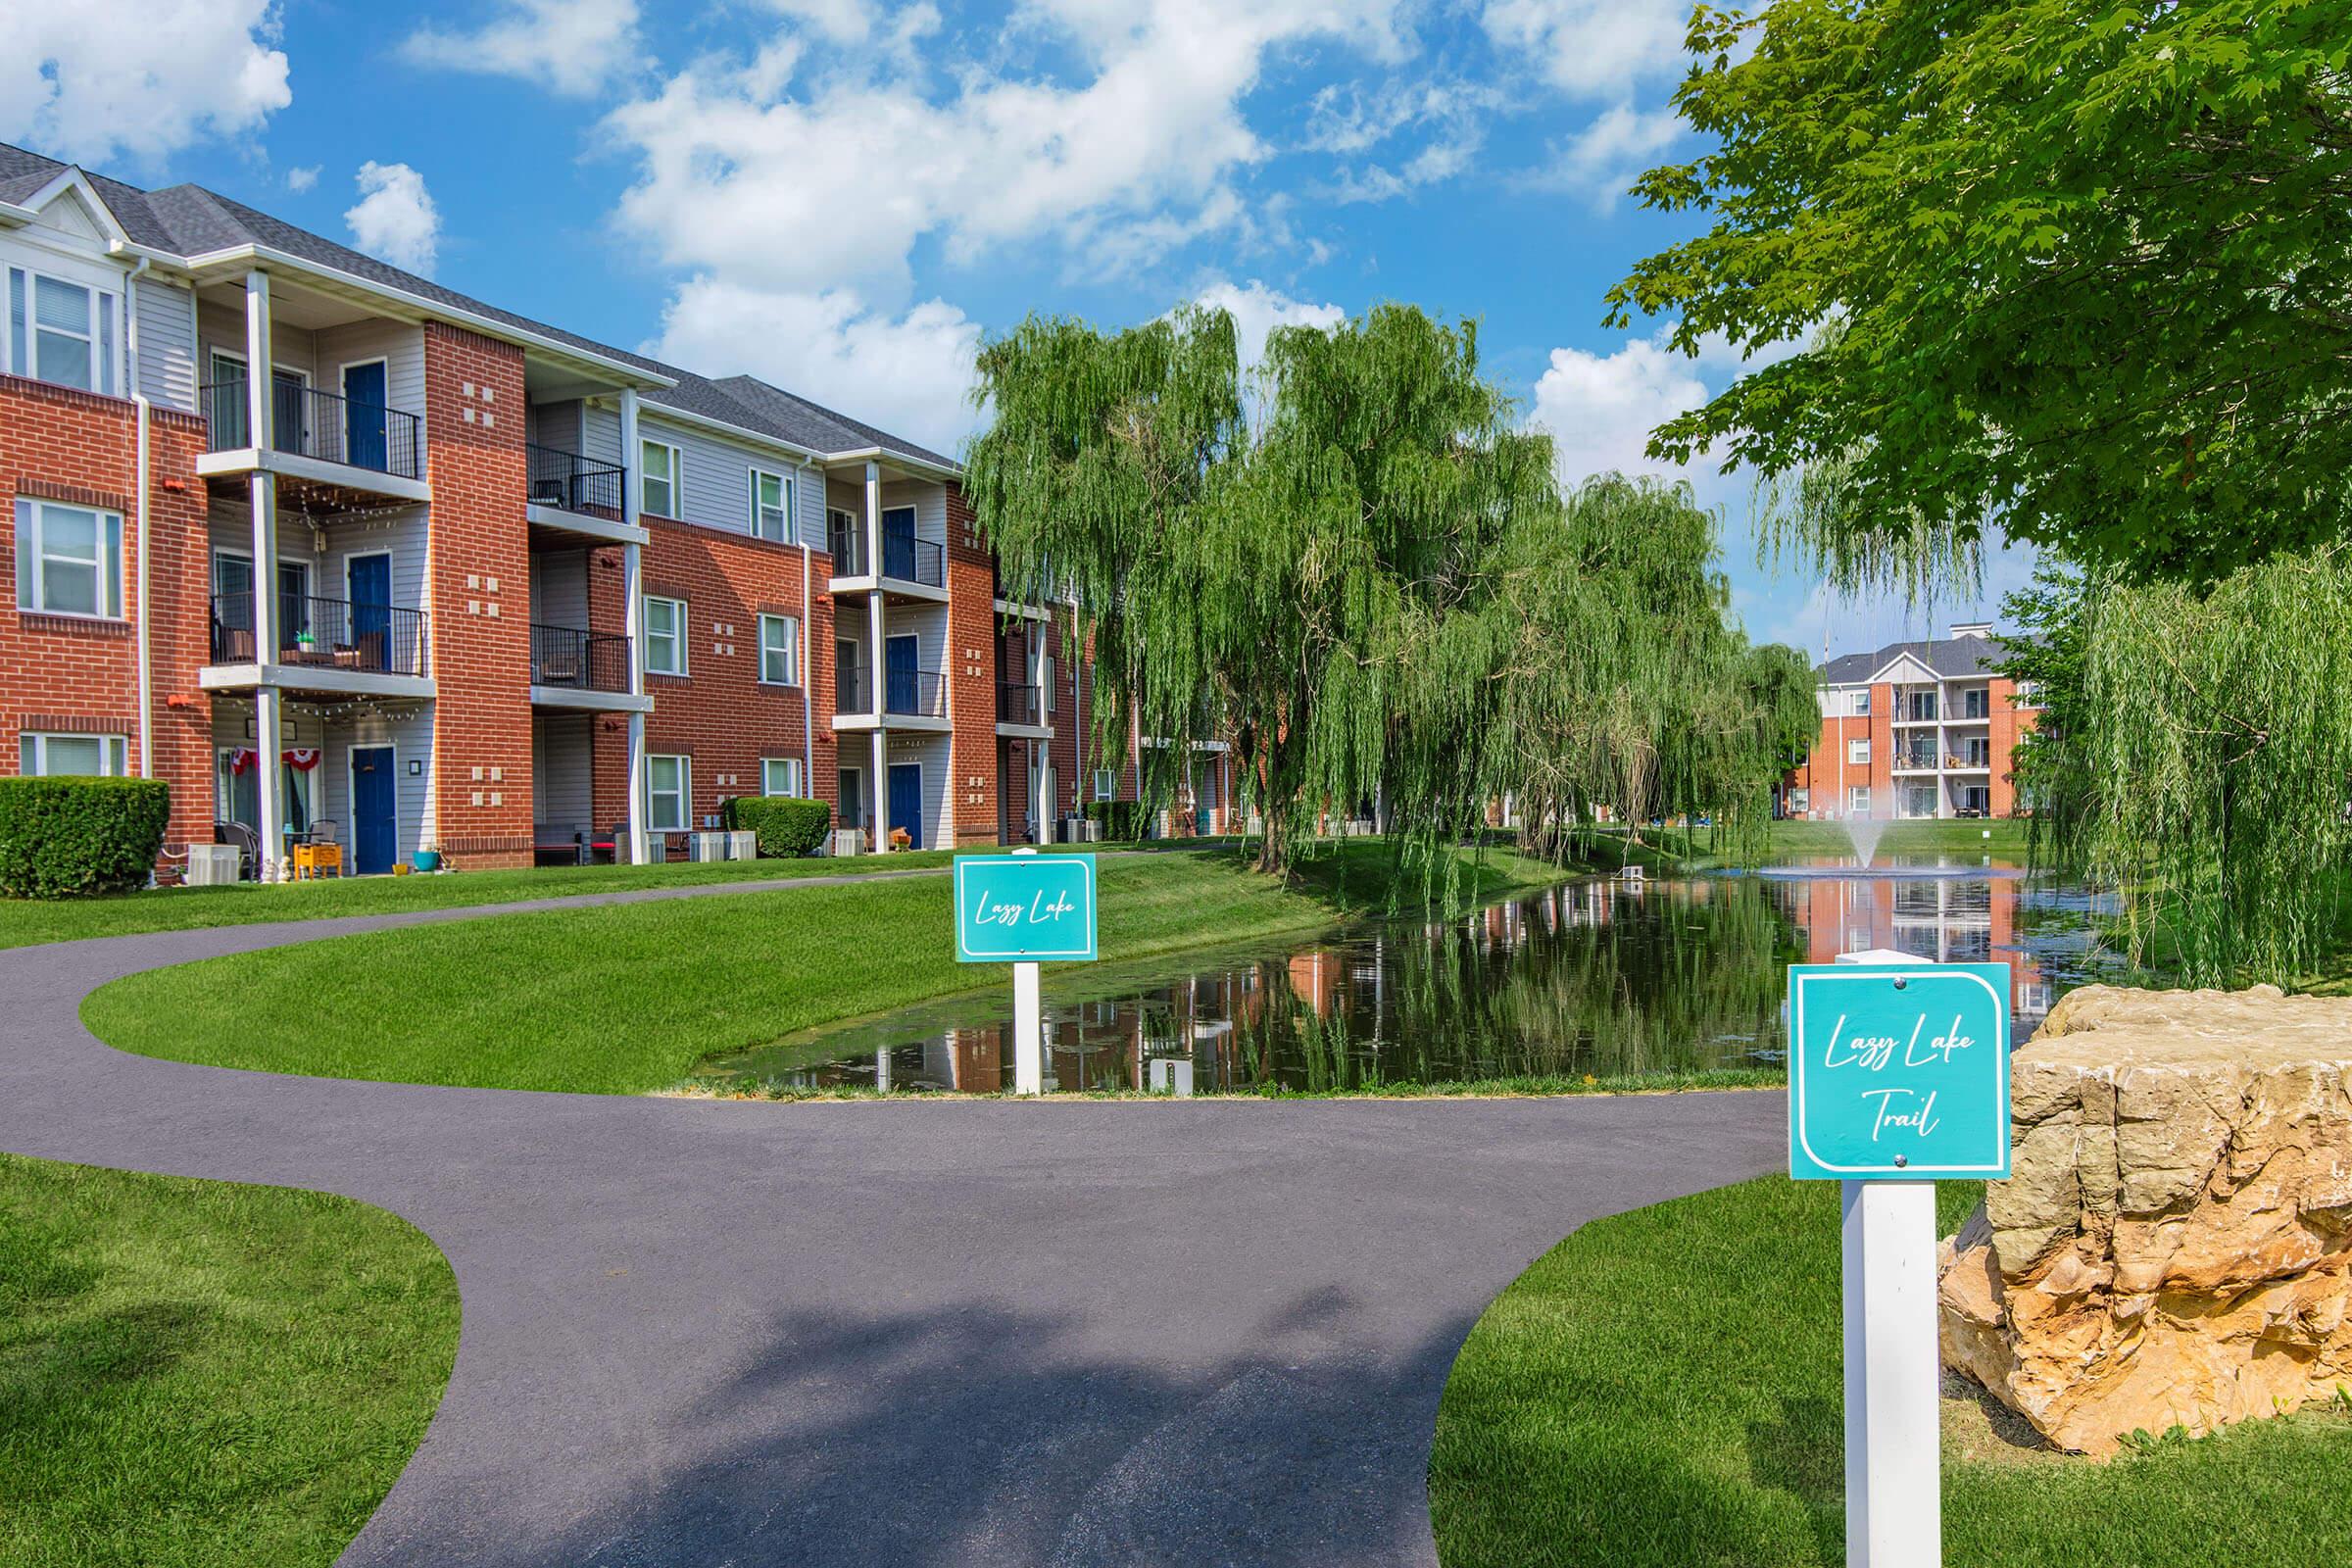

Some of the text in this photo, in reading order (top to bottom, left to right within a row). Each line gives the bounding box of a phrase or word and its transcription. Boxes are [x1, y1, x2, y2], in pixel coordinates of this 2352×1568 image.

[975, 889, 1075, 926] Lazy Lake
[1825, 1012, 1976, 1071] Lazy Lake
[1861, 1089, 1940, 1142] Trail
